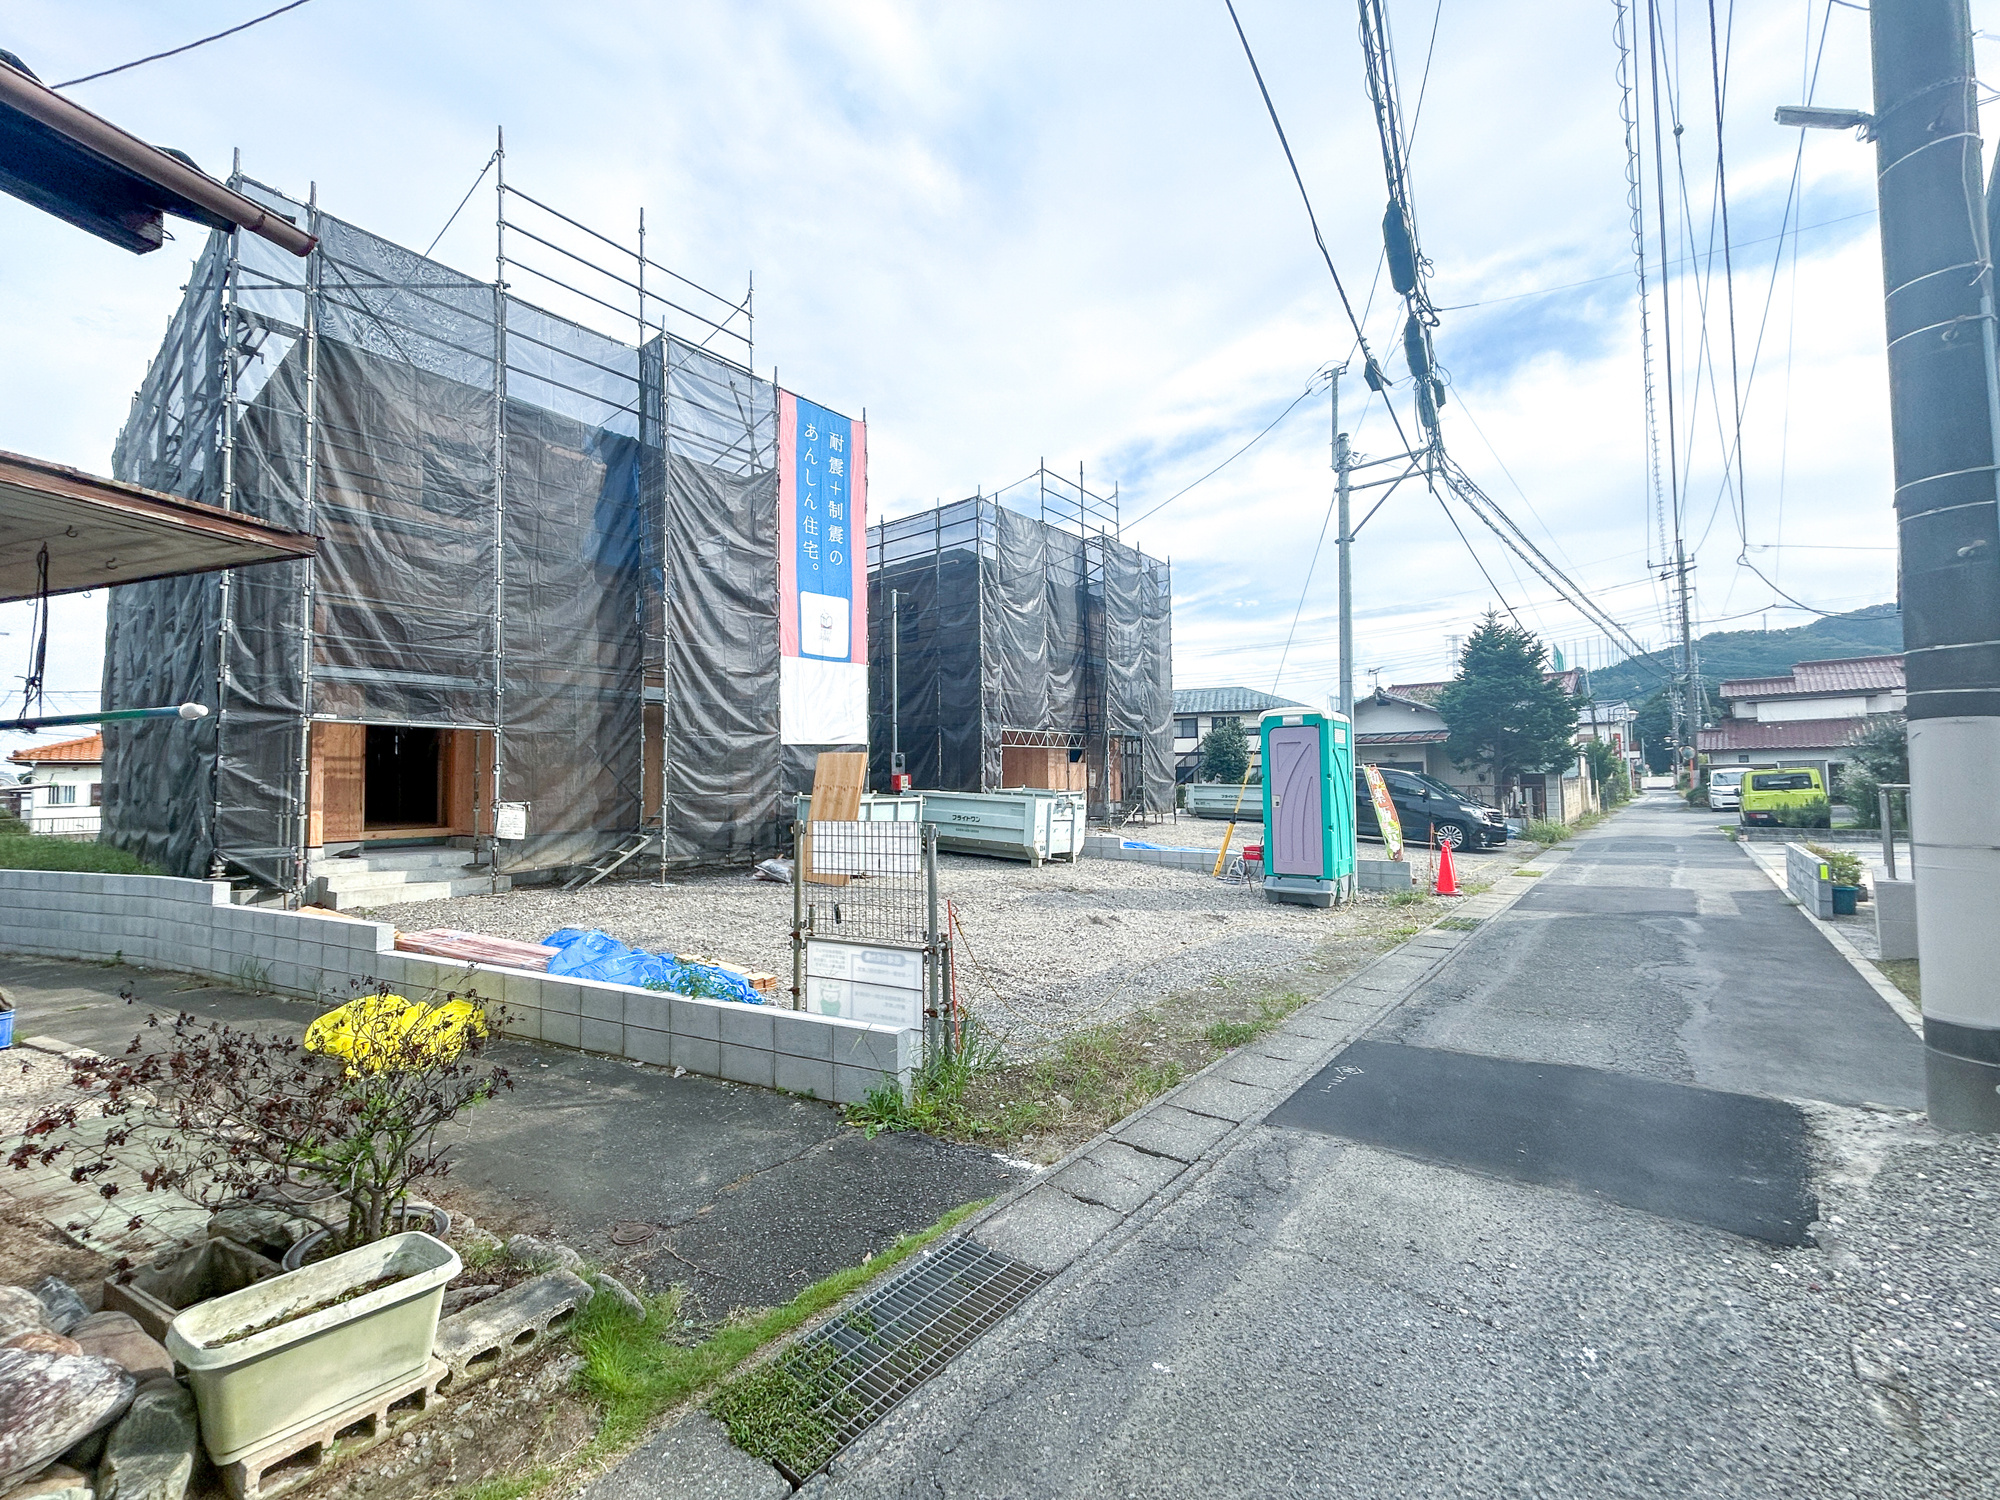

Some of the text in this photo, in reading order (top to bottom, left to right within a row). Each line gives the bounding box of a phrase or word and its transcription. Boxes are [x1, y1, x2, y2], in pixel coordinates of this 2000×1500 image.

[802, 422, 819, 571] あんしん住宅。
